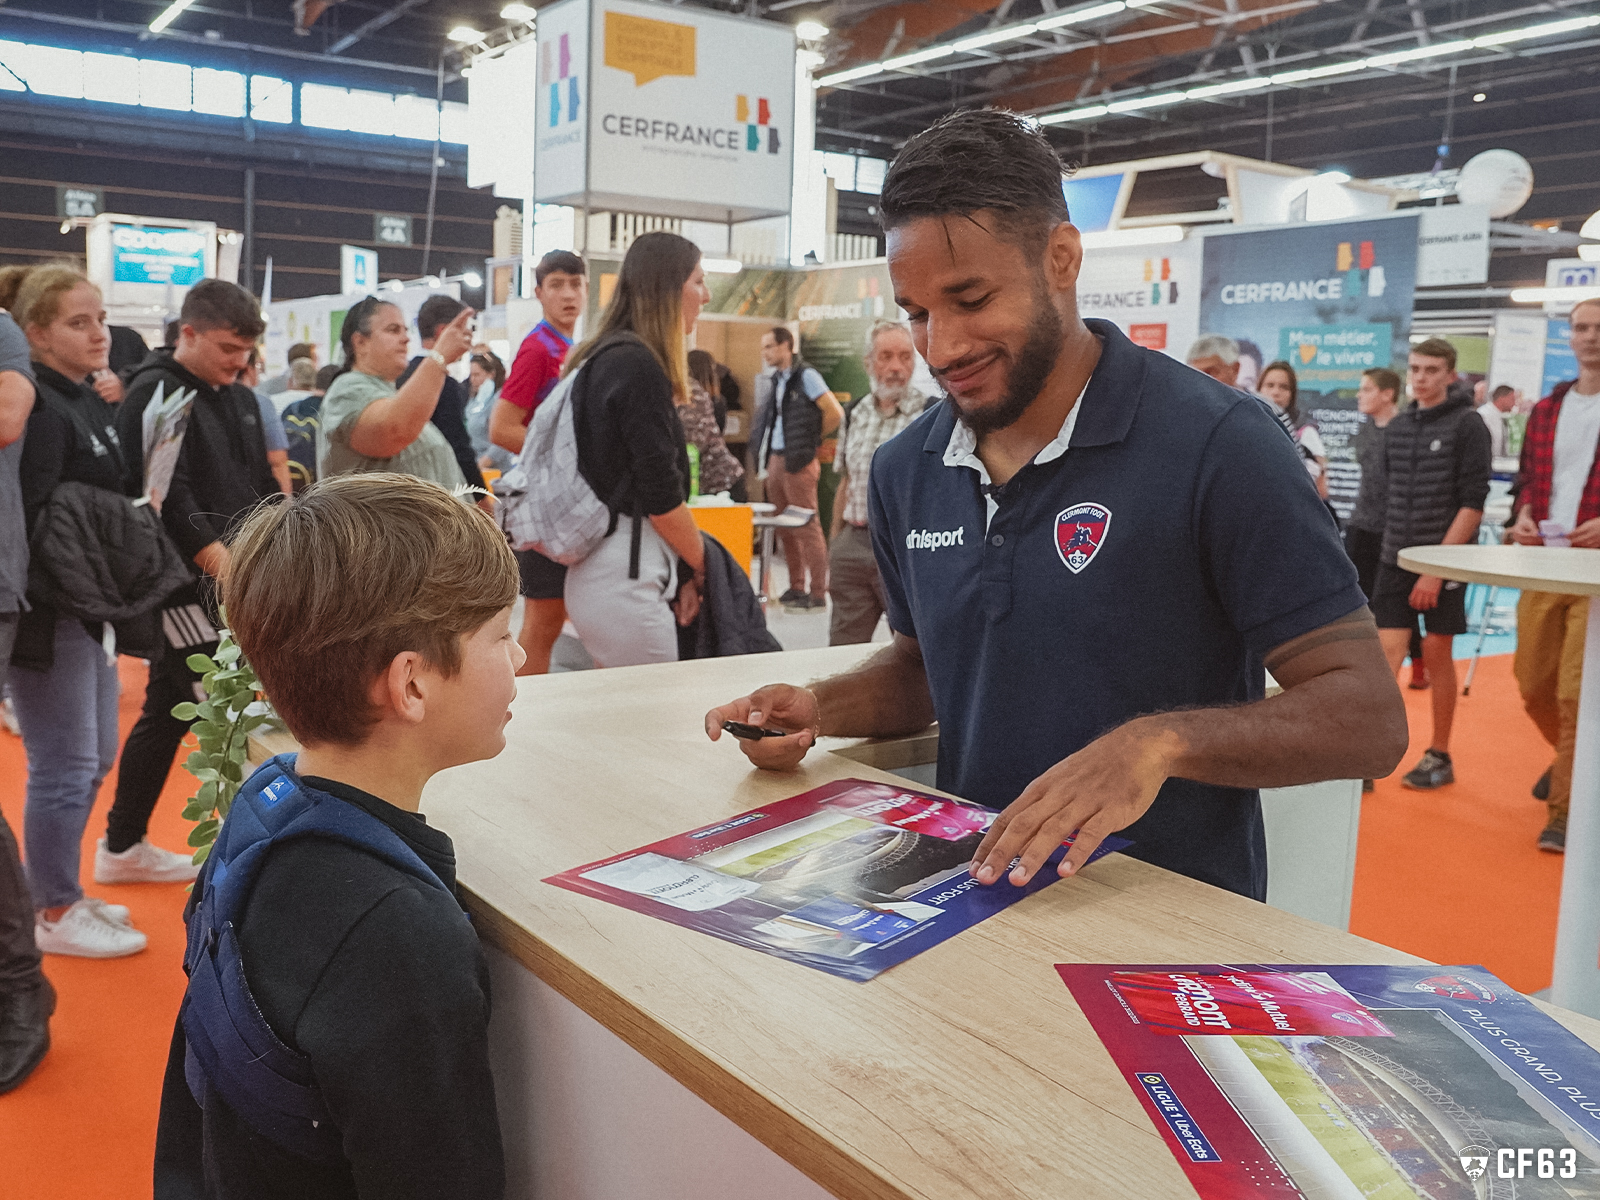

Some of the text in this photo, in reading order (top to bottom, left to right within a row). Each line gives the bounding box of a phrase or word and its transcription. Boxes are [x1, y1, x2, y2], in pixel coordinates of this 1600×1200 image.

[602, 114, 739, 151] CERFRANCE
[1220, 278, 1343, 305] CERFRANCE
[1288, 330, 1322, 346] Mon
[1334, 348, 1375, 366] vivre
[1061, 507, 1106, 522] CLERMONT FOOT
[1071, 555, 1085, 565] 63
[927, 877, 981, 905] LUS FORT
[1258, 1000, 1296, 1031] Mutuel
[1462, 1008, 1509, 1037] PLUS
[1500, 1038, 1563, 1084] GRAND,
[1151, 1086, 1180, 1112] LIGUE
[1174, 1120, 1195, 1139] Uber
[1186, 1139, 1208, 1159] Eats
